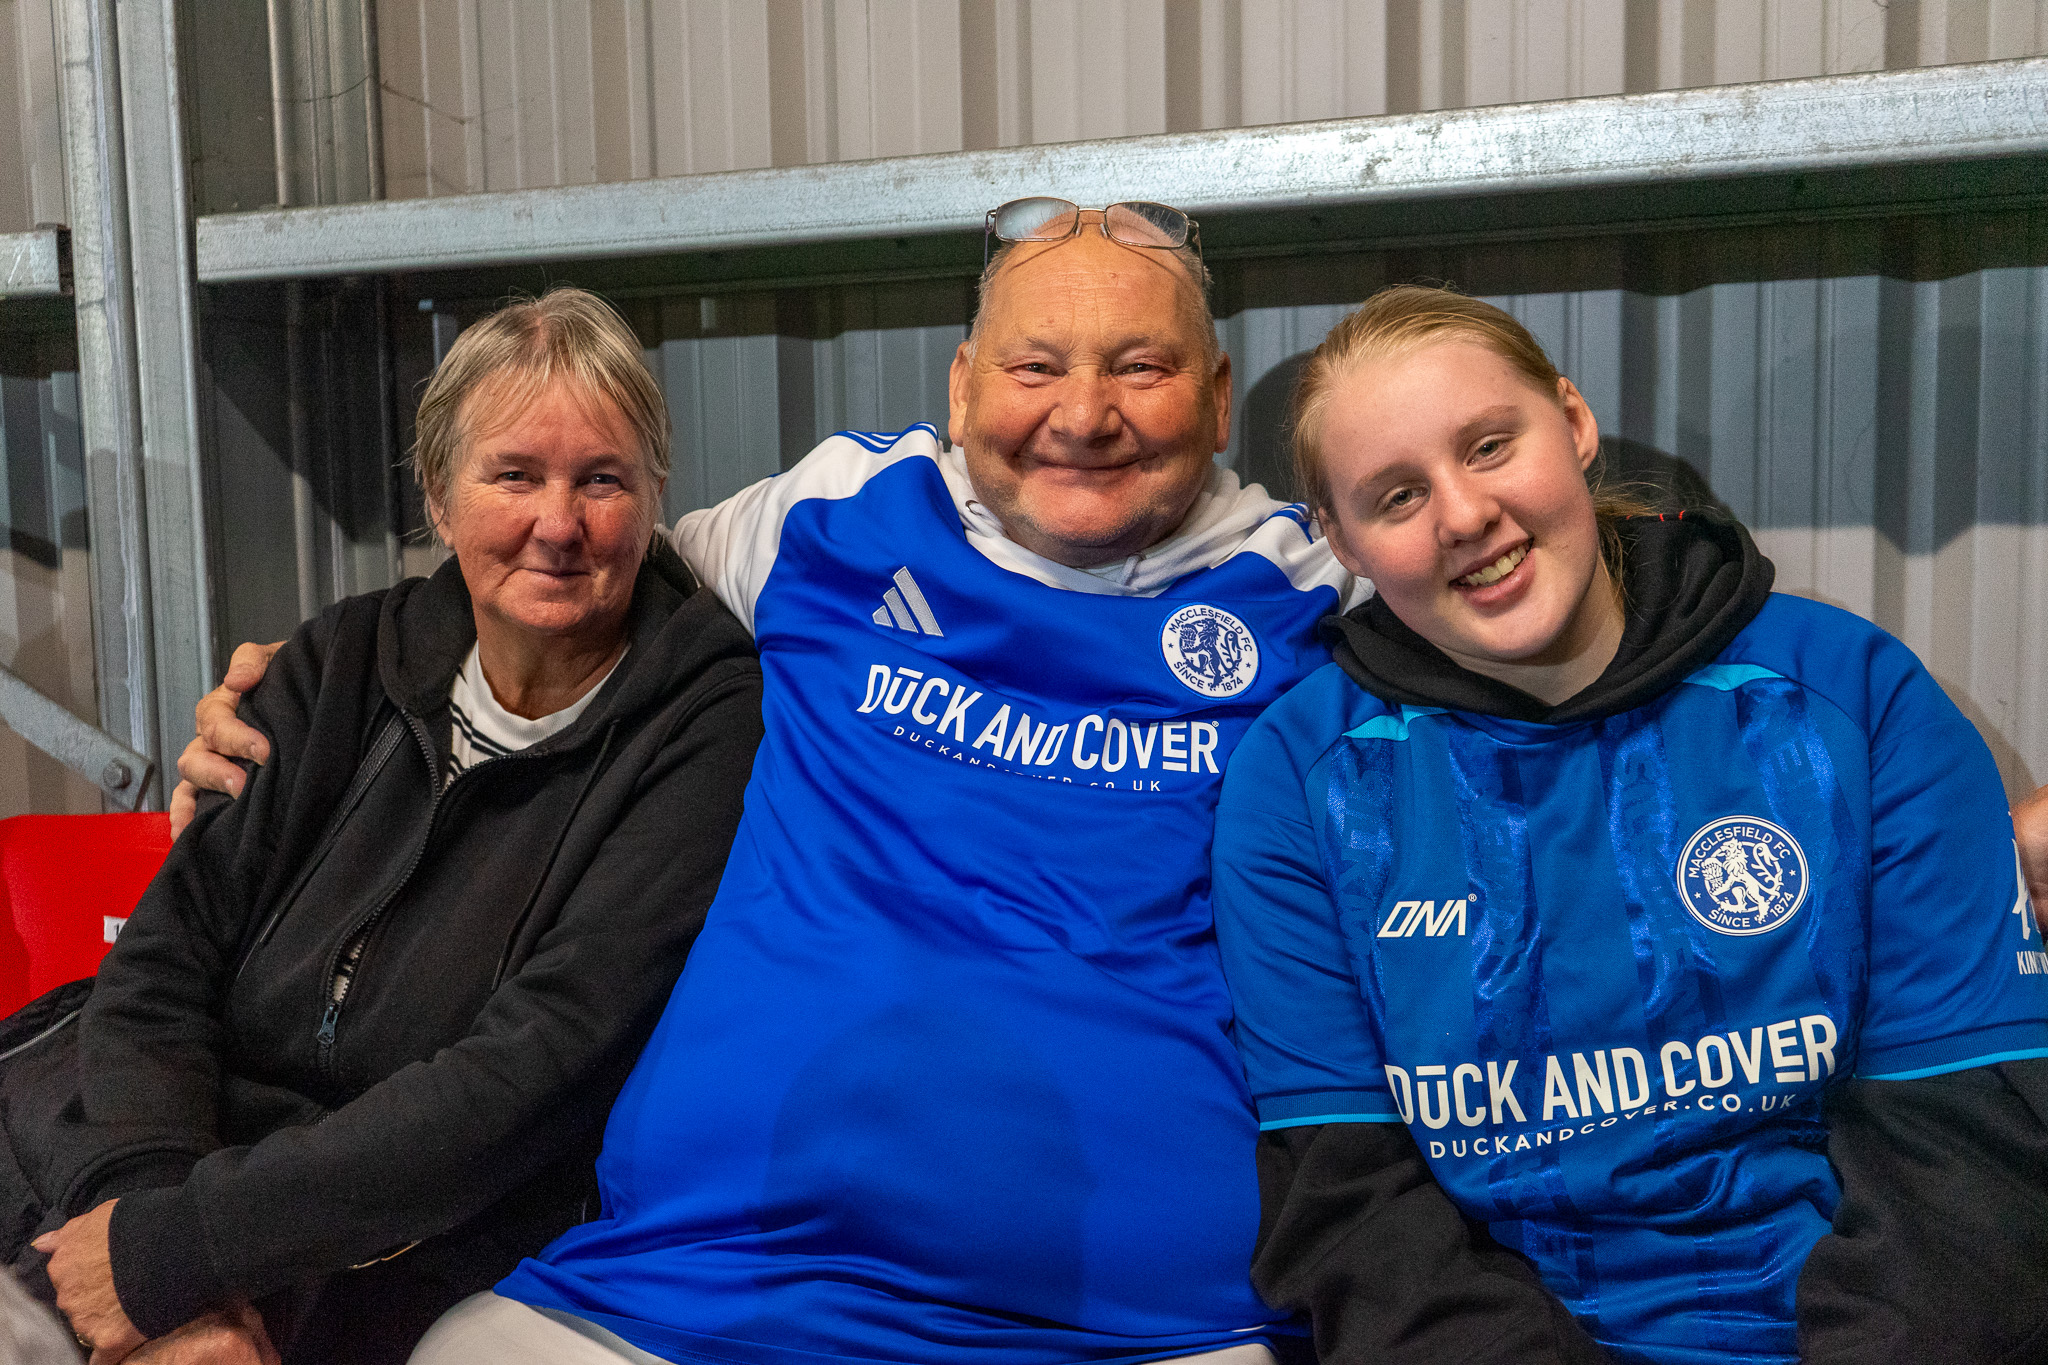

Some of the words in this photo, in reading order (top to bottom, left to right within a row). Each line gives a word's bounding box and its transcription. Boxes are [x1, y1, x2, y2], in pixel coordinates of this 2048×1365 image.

[1168, 608, 1243, 635] MACCLESFIELD
[1241, 637, 1253, 652] FC
[1173, 661, 1205, 689] SINCE
[1221, 676, 1243, 692] 1874
[972, 703, 1070, 766] AND
[1688, 826, 1773, 878] MACCLESFIELD
[1773, 841, 1791, 859] FC
[1708, 909, 1751, 928] SINCE
[1770, 891, 1795, 918] 1874
[1542, 1047, 1650, 1122] AND
[1659, 1014, 1838, 1100] COVER
[1429, 1092, 1798, 1160] DUCKANDCOVER.CO.UK
